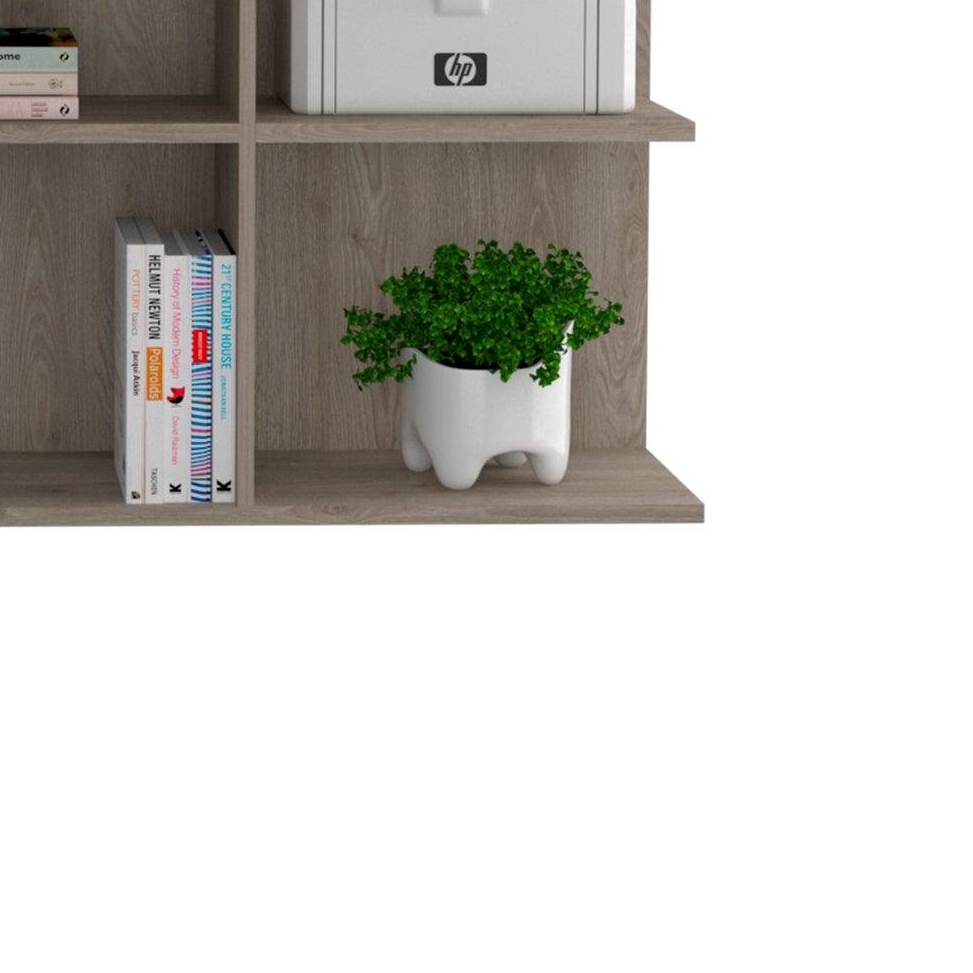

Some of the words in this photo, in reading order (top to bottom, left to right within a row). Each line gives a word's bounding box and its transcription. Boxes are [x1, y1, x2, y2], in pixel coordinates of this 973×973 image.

[131, 269, 141, 310] POTTERY
[149, 255, 161, 295] HELMUT
[171, 268, 181, 298] History
[149, 298, 161, 339] NEWTON
[171, 300, 181, 310] of
[221, 283, 233, 331] CENTURY
[131, 312, 140, 336] basics
[171, 312, 181, 347] Modern
[131, 349, 141, 373] Jacqui
[171, 348, 181, 379] Design
[221, 333, 233, 370] HOUSE
[131, 375, 141, 396] Atkin
[149, 348, 161, 400] Polaroids
